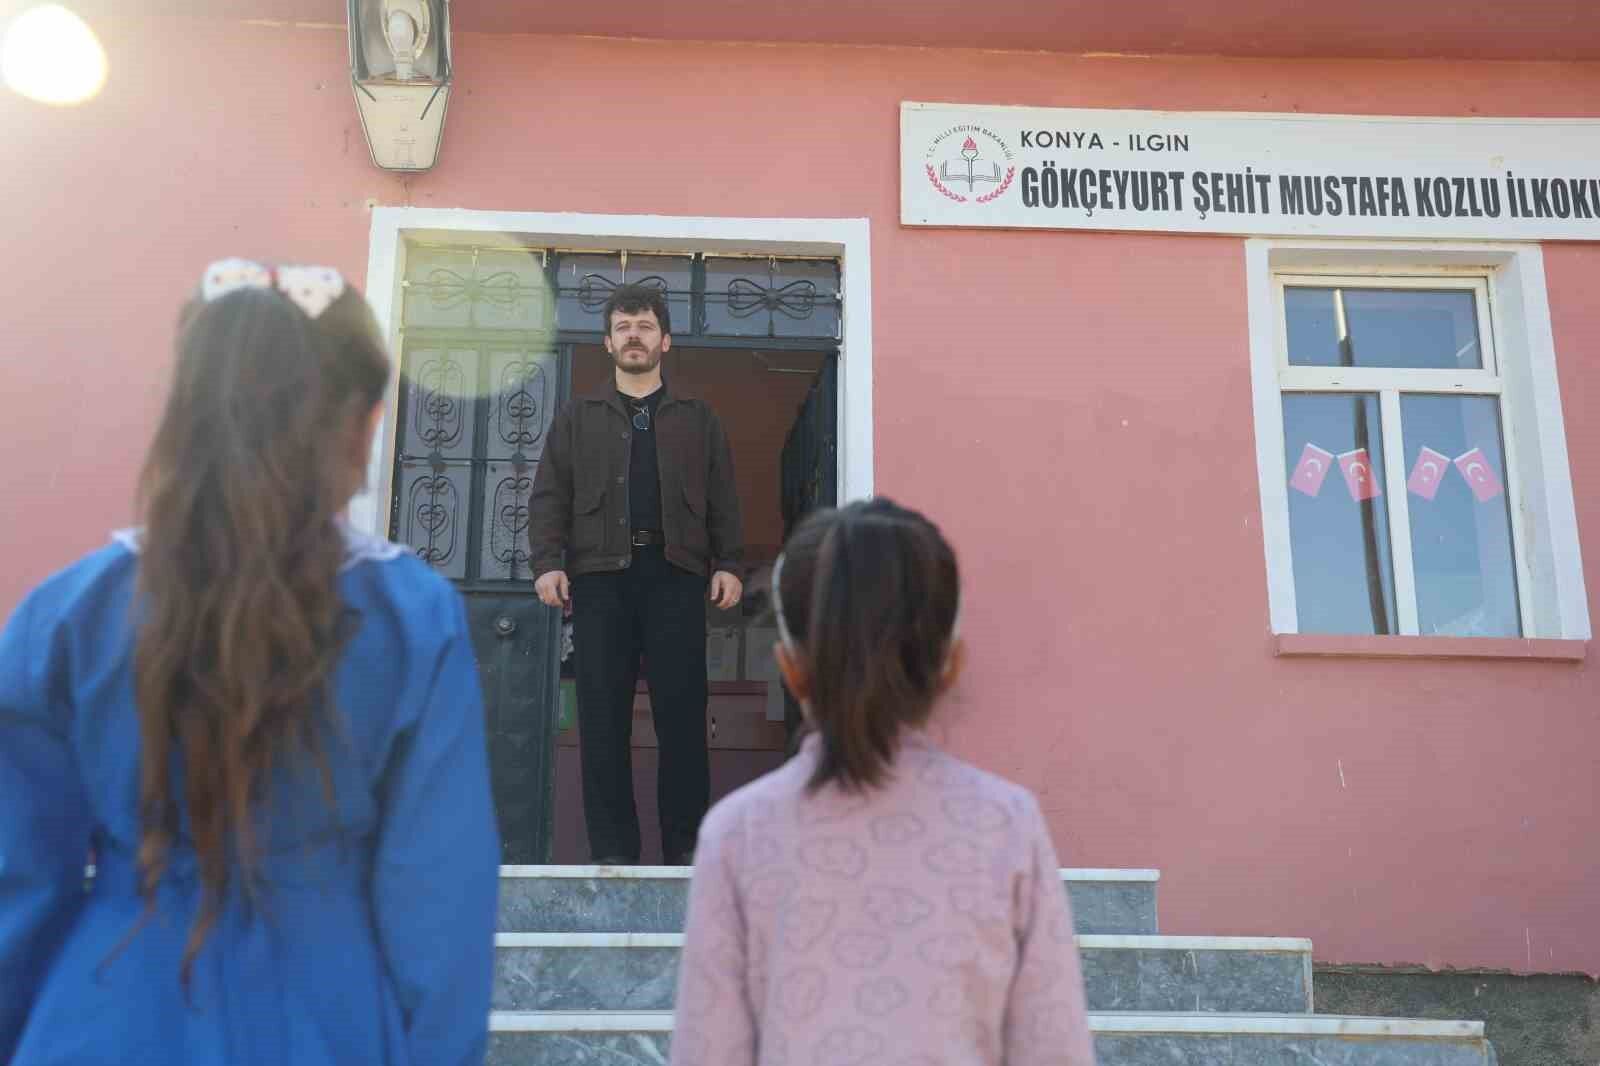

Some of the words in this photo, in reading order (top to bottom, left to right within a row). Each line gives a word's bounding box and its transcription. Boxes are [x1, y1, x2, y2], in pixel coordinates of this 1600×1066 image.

[1020, 130, 1104, 150] KONYA
[1128, 133, 1190, 152] ILGIN
[1021, 160, 1185, 218] GÖKÇEYURT
[1192, 166, 1272, 221] ŞEHİT
[1278, 174, 1410, 217] MUSTAFA
[1414, 176, 1501, 218] KOZLU
